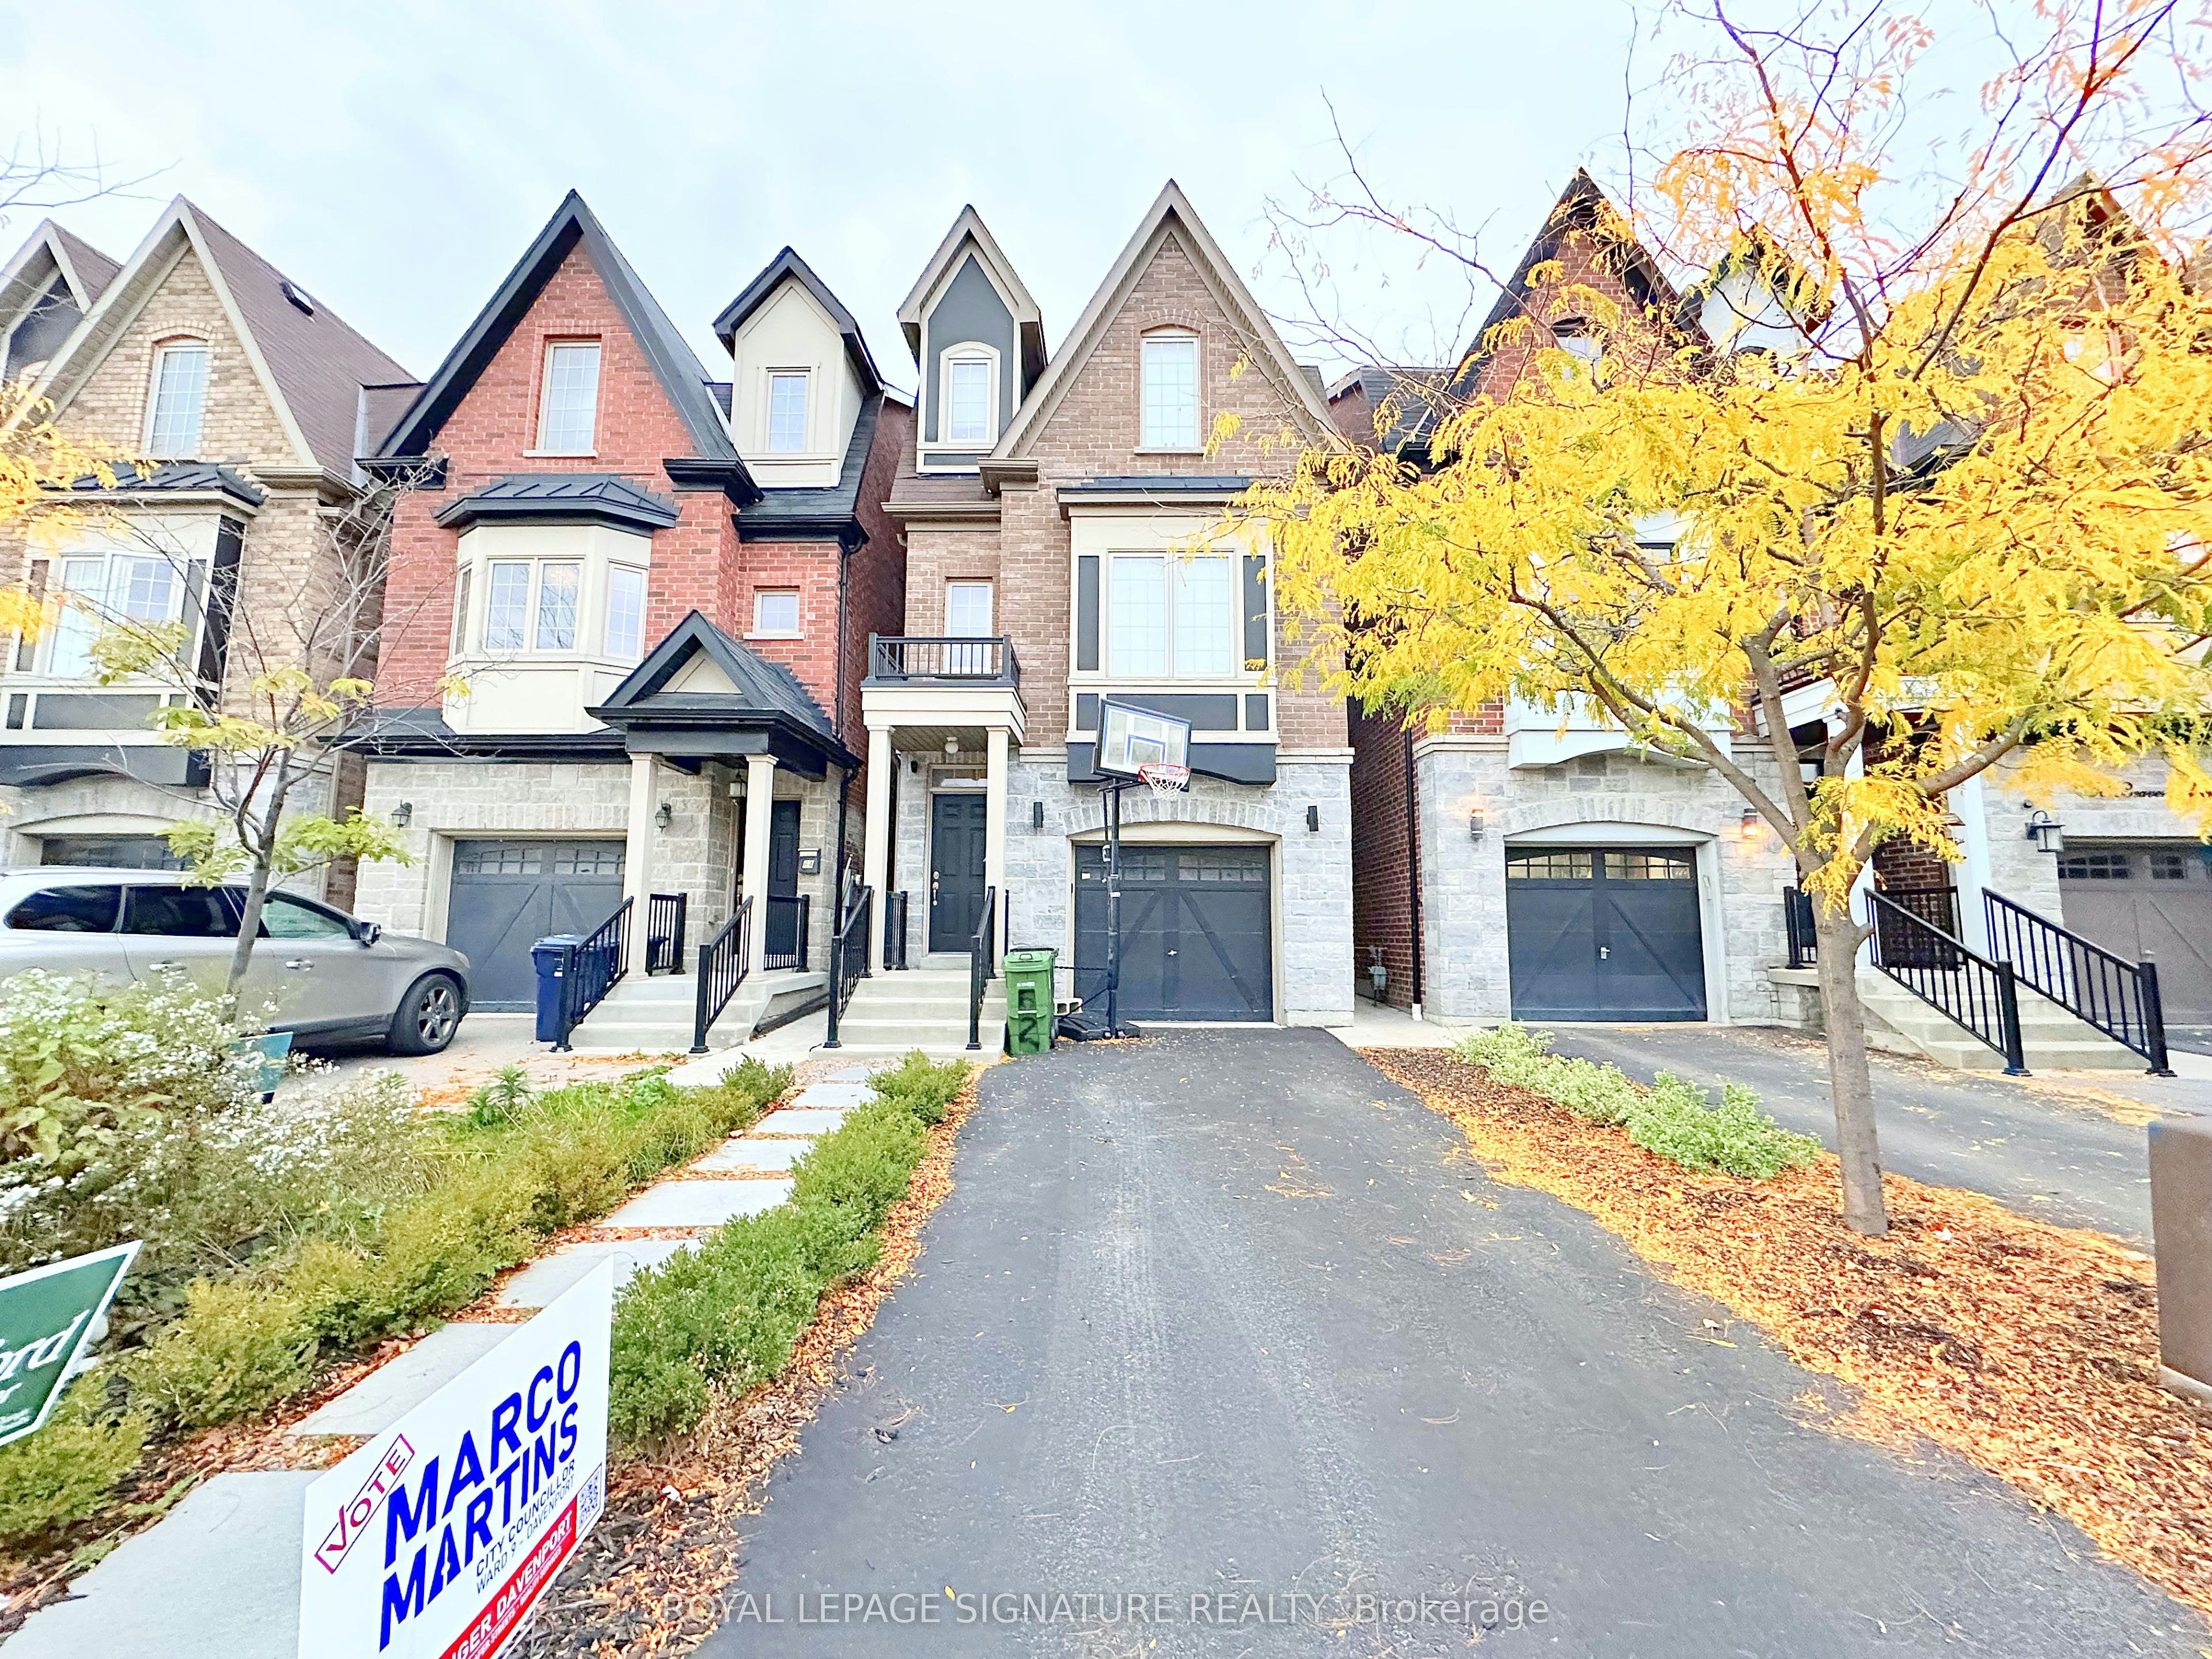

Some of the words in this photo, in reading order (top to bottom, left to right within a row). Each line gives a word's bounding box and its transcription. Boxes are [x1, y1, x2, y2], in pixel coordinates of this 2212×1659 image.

[326, 1448, 406, 1551] VOTE
[384, 1340, 581, 1570] MARCO
[379, 1402, 578, 1653] MARTINS
[476, 1535, 505, 1577] CITY
[509, 1459, 575, 1543] COUNCILLOR
[476, 1551, 507, 1594] WARD
[511, 1544, 517, 1558] 9
[527, 1474, 575, 1540] DAVENPORT
[497, 1509, 573, 1622] DAVENPORT
